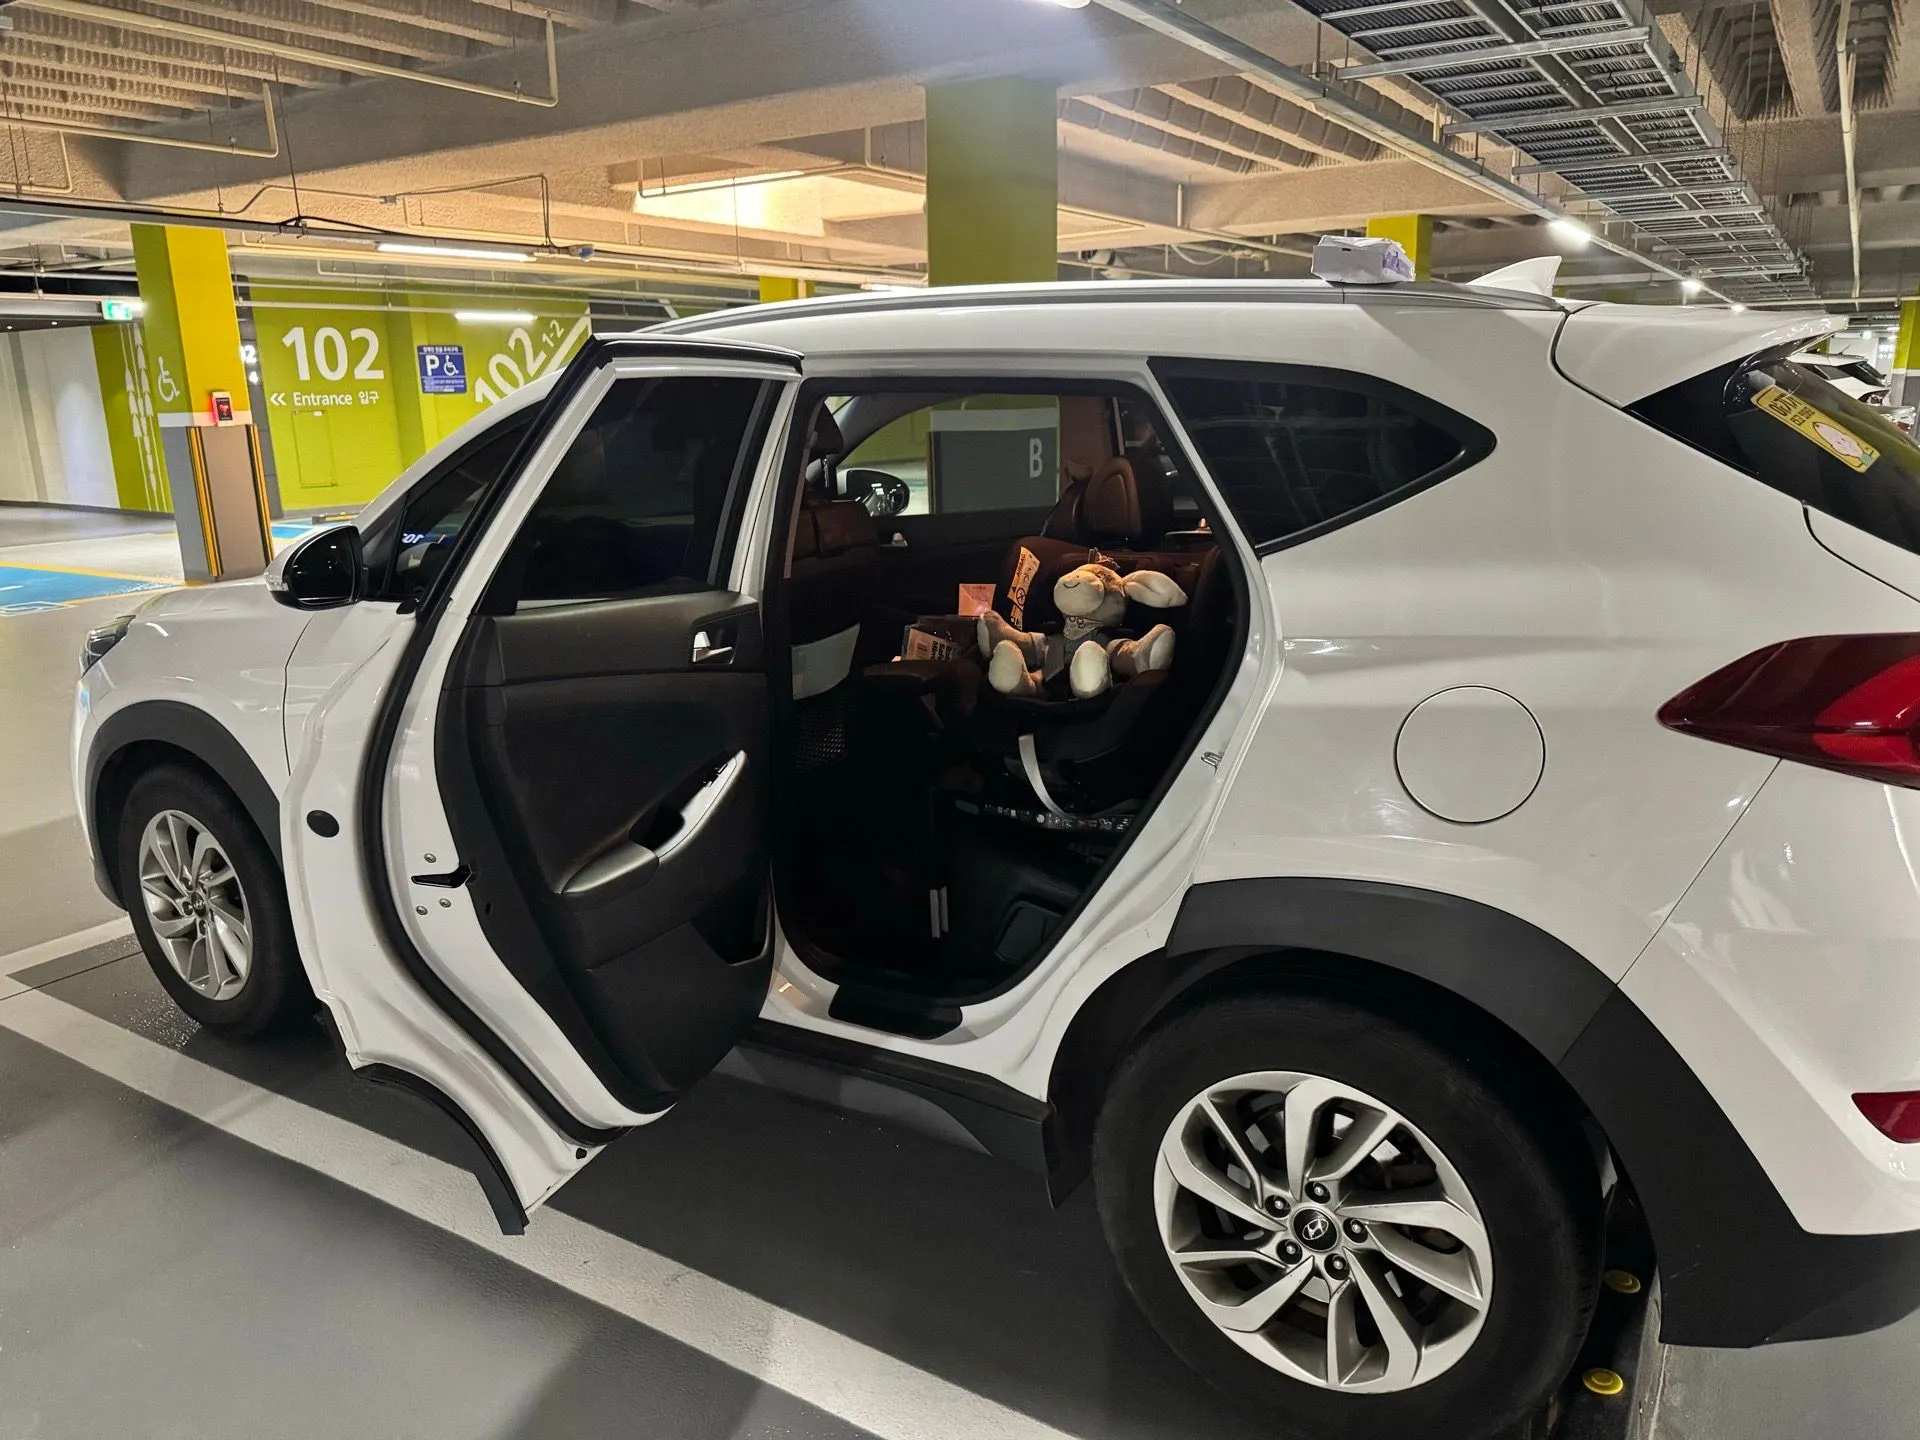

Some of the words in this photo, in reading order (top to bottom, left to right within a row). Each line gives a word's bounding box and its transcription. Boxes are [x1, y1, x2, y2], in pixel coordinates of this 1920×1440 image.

[542, 319, 564, 348] 1-2
[281, 326, 385, 381] 102
[425, 354, 440, 377] P
[475, 327, 547, 405] 102
[292, 391, 353, 406] Entrance
[358, 390, 379, 405] 입구
[1029, 438, 1043, 478] B
